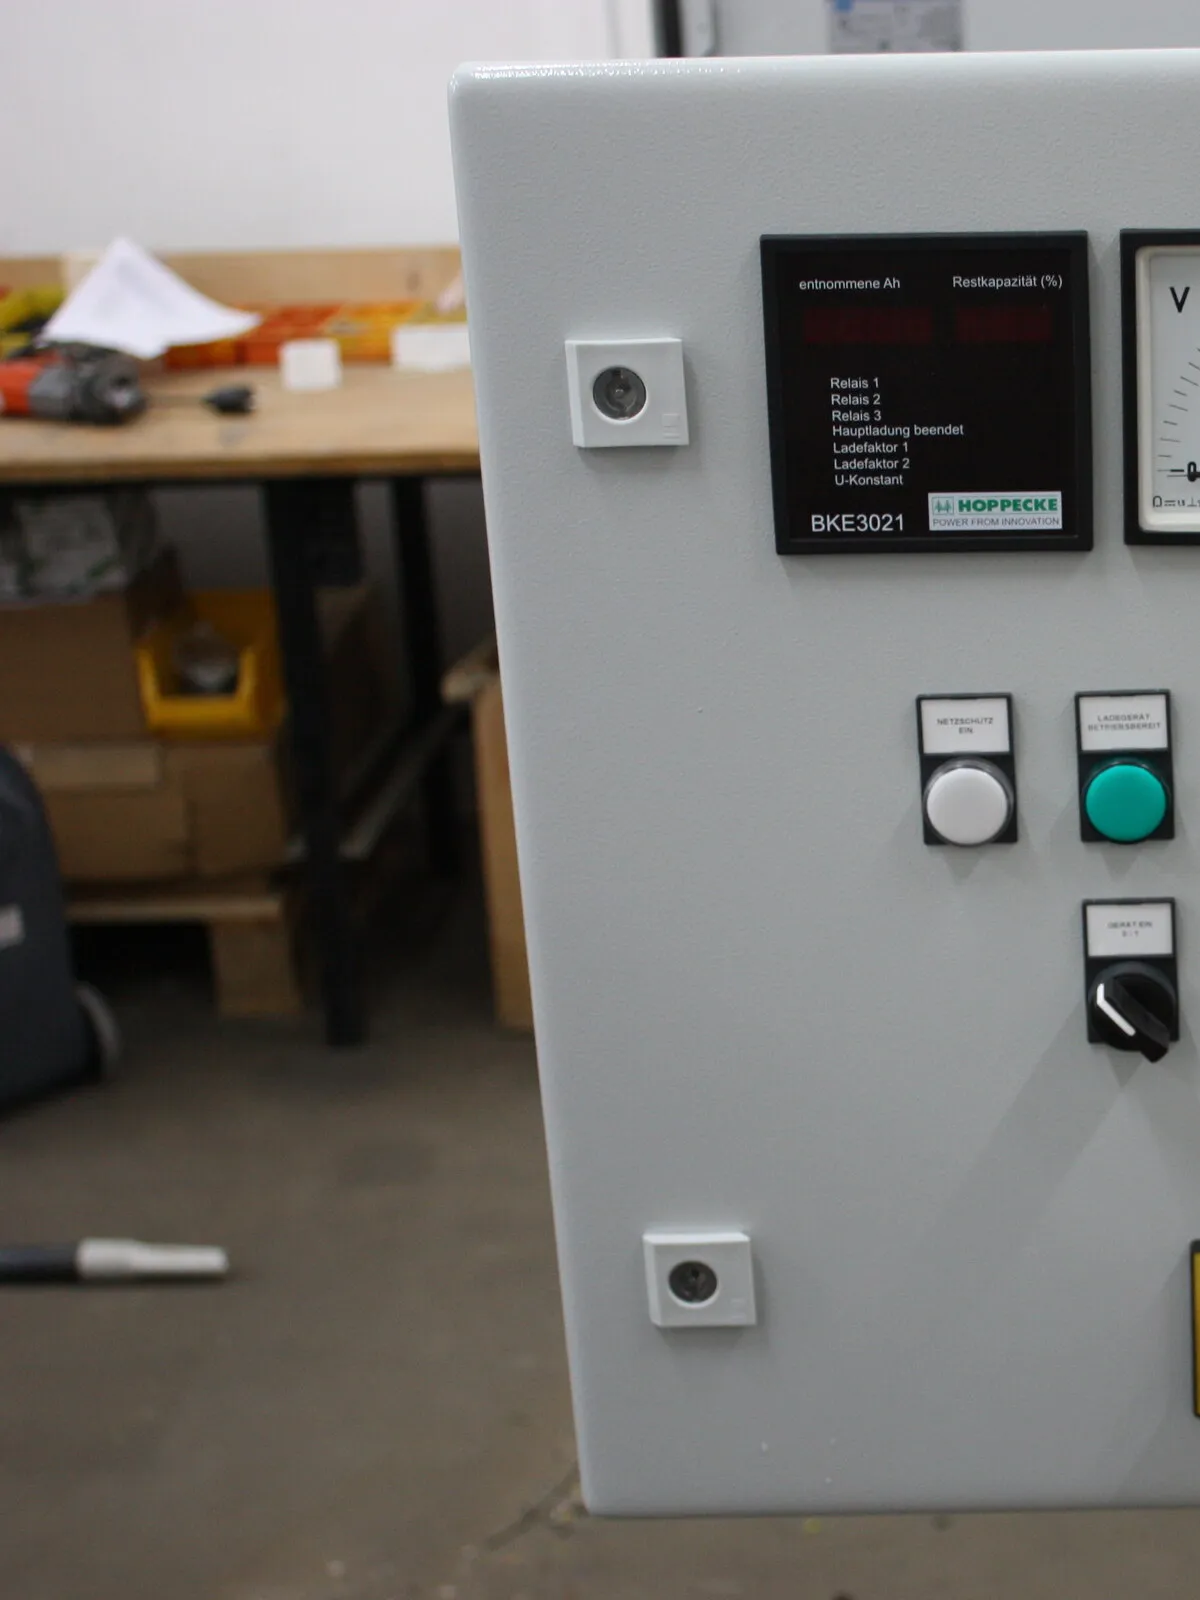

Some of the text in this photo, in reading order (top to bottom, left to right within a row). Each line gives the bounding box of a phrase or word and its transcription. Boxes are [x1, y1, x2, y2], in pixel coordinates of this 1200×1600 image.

[799, 277, 901, 289] entnommene Ah
[952, 275, 1063, 290] Restkapazität (%)
[1169, 286, 1190, 313] V
[830, 377, 880, 389] Relais 1
[831, 393, 881, 405] Relais 2
[832, 410, 882, 422] Relais 3
[832, 424, 964, 438] Hauptladung beendet
[833, 442, 909, 453] Ladefaktor 1
[834, 457, 910, 469] Ladefaktor 2
[1187, 461, 1198, 482] 0
[834, 474, 904, 486] U-Konstant
[958, 498, 1058, 512] HOPPECKE
[811, 513, 905, 532] BKE3021
[932, 517, 1060, 527] POWER FROM INNOVATION
